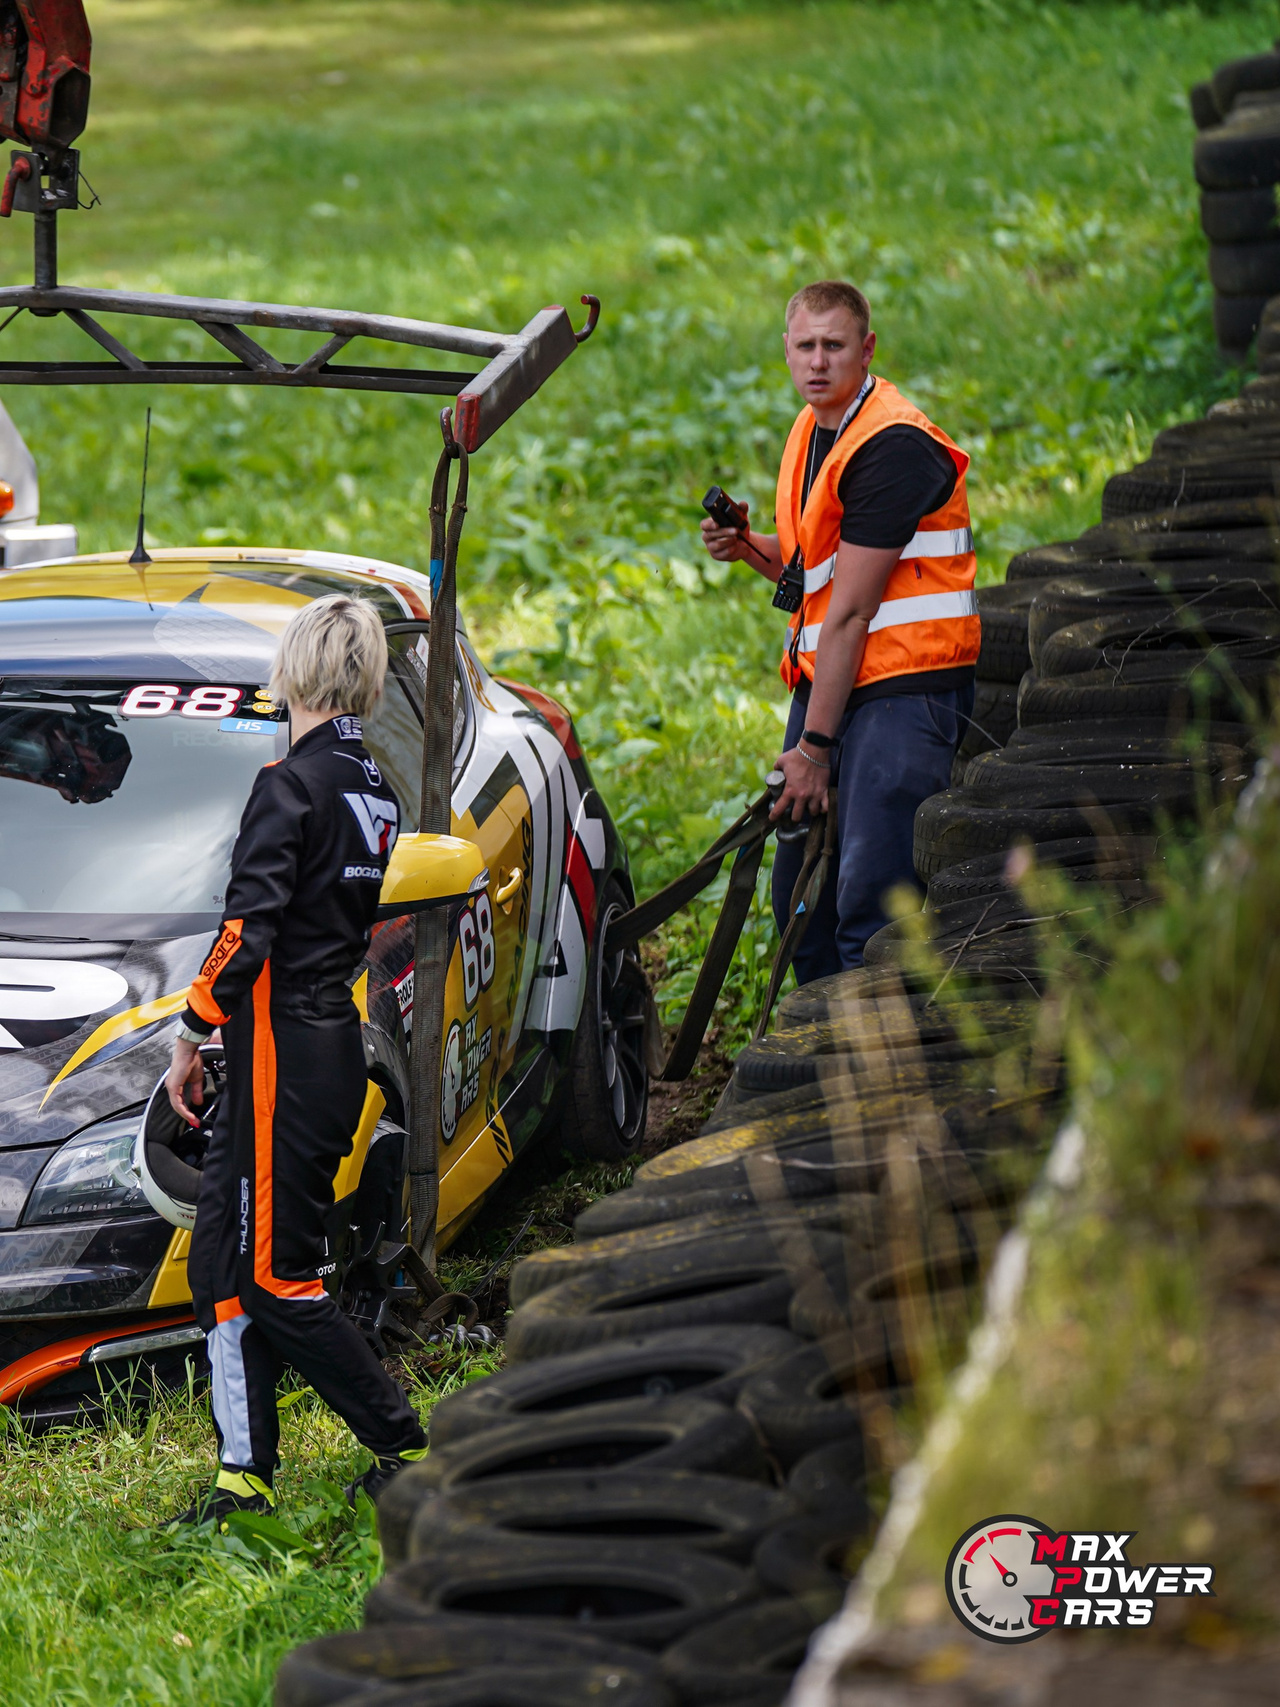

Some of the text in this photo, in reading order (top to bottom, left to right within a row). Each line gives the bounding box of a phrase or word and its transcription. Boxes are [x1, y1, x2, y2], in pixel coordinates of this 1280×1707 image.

[121, 684, 243, 718] 68
[235, 720, 263, 731] HS
[344, 866, 383, 879] BOGD
[459, 889, 495, 1008] 68
[240, 1176, 249, 1255] THUNDER
[316, 1263, 336, 1277] OTOR
